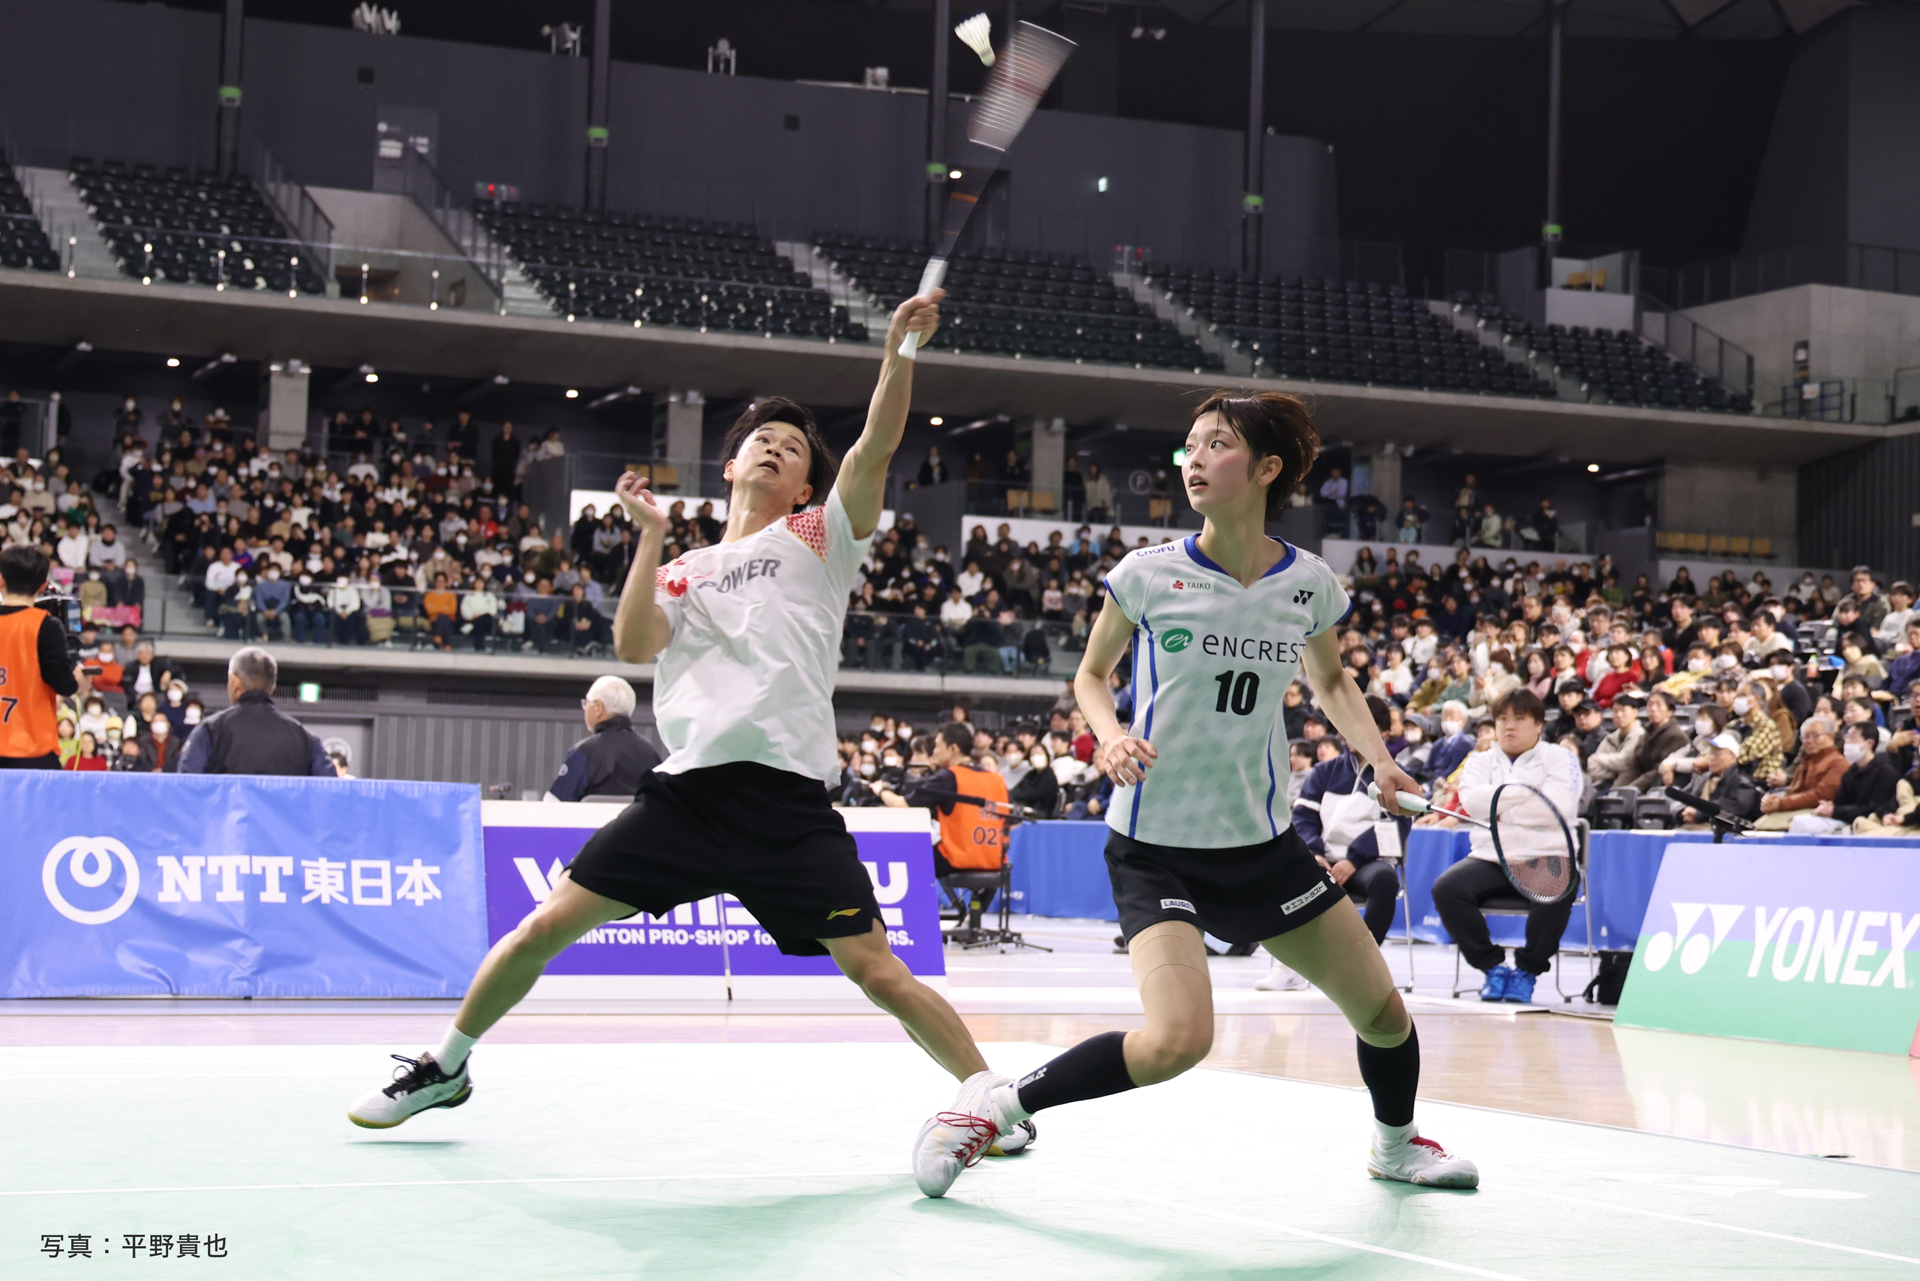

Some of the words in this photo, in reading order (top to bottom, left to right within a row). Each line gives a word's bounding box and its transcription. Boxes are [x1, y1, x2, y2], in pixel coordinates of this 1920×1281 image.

[697, 558, 782, 594] POWER
[1187, 582, 1211, 590] TAIKO
[1214, 669, 1261, 716] 10
[648, 928, 751, 946] PRO-SHOP
[1746, 906, 1920, 990] YONEX
